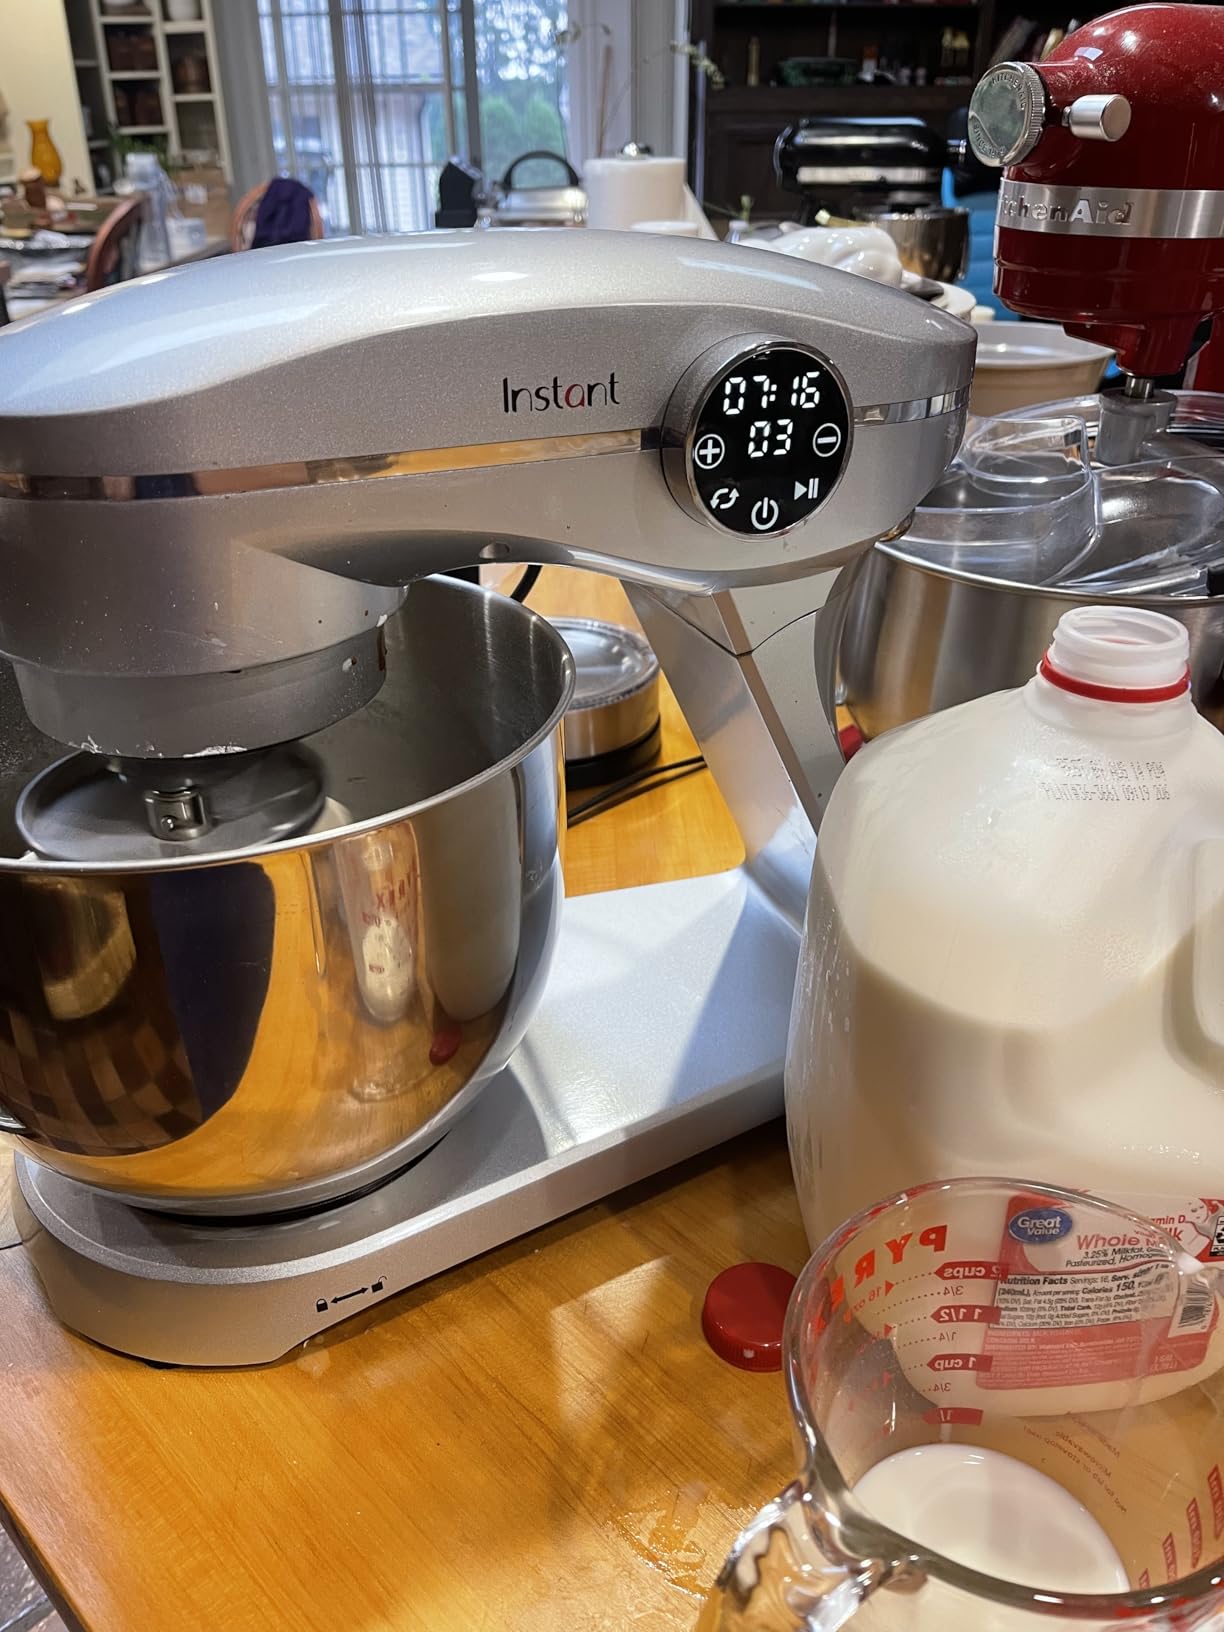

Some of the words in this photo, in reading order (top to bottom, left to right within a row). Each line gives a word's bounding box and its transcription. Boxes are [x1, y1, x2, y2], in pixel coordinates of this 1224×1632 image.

[502, 372, 620, 413] Instant
[723, 371, 820, 415] 07:16
[748, 418, 793, 458] 03
[1017, 1214, 1062, 1228] Great
[1027, 1225, 1060, 1236] Value
[1077, 1234, 1140, 1250] Whole
[1083, 1249, 1108, 1259] 3.25%
[1043, 1276, 1067, 1285] Facts
[1082, 1286, 1113, 1295] Calories
